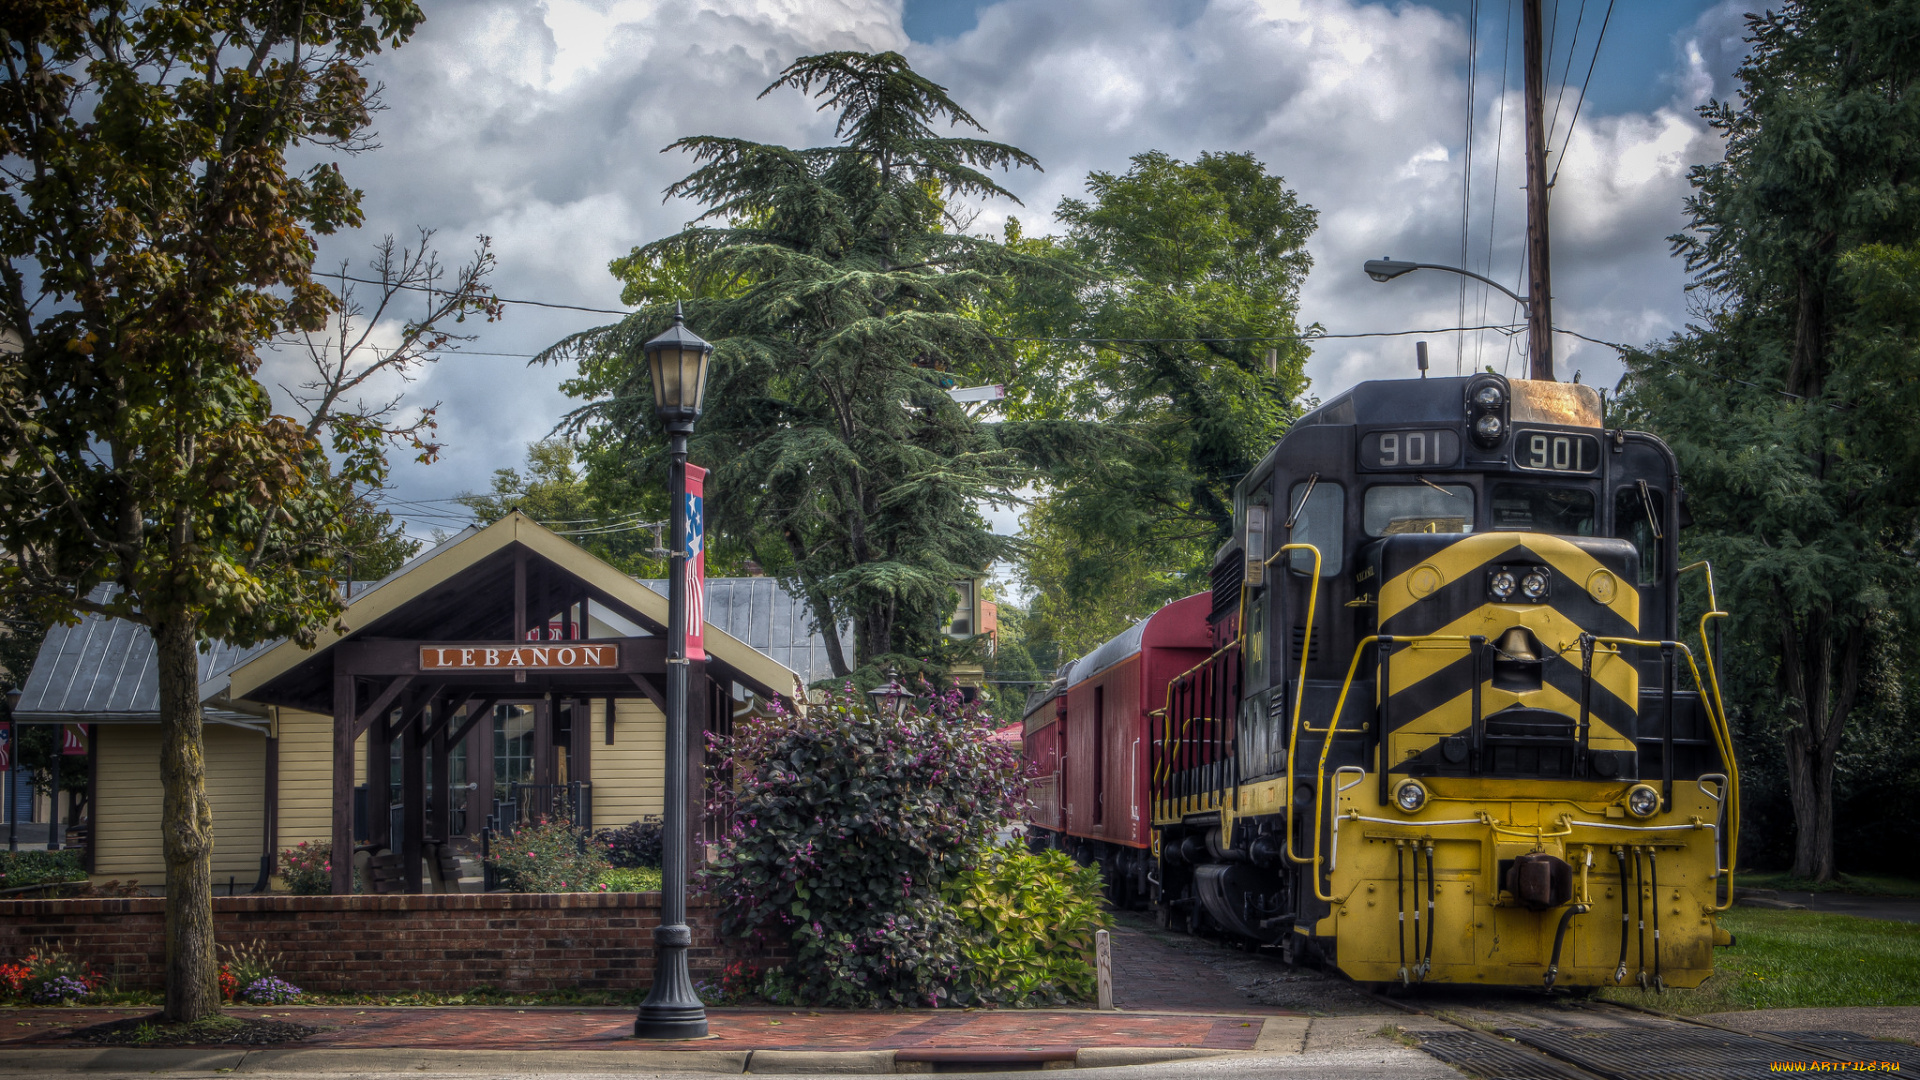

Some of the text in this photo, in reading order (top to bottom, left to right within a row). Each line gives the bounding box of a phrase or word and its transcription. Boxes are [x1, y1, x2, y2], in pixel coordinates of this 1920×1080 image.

[1379, 432, 1440, 467] 901
[1530, 434, 1583, 471] 901
[436, 647, 603, 667] LEBANON
